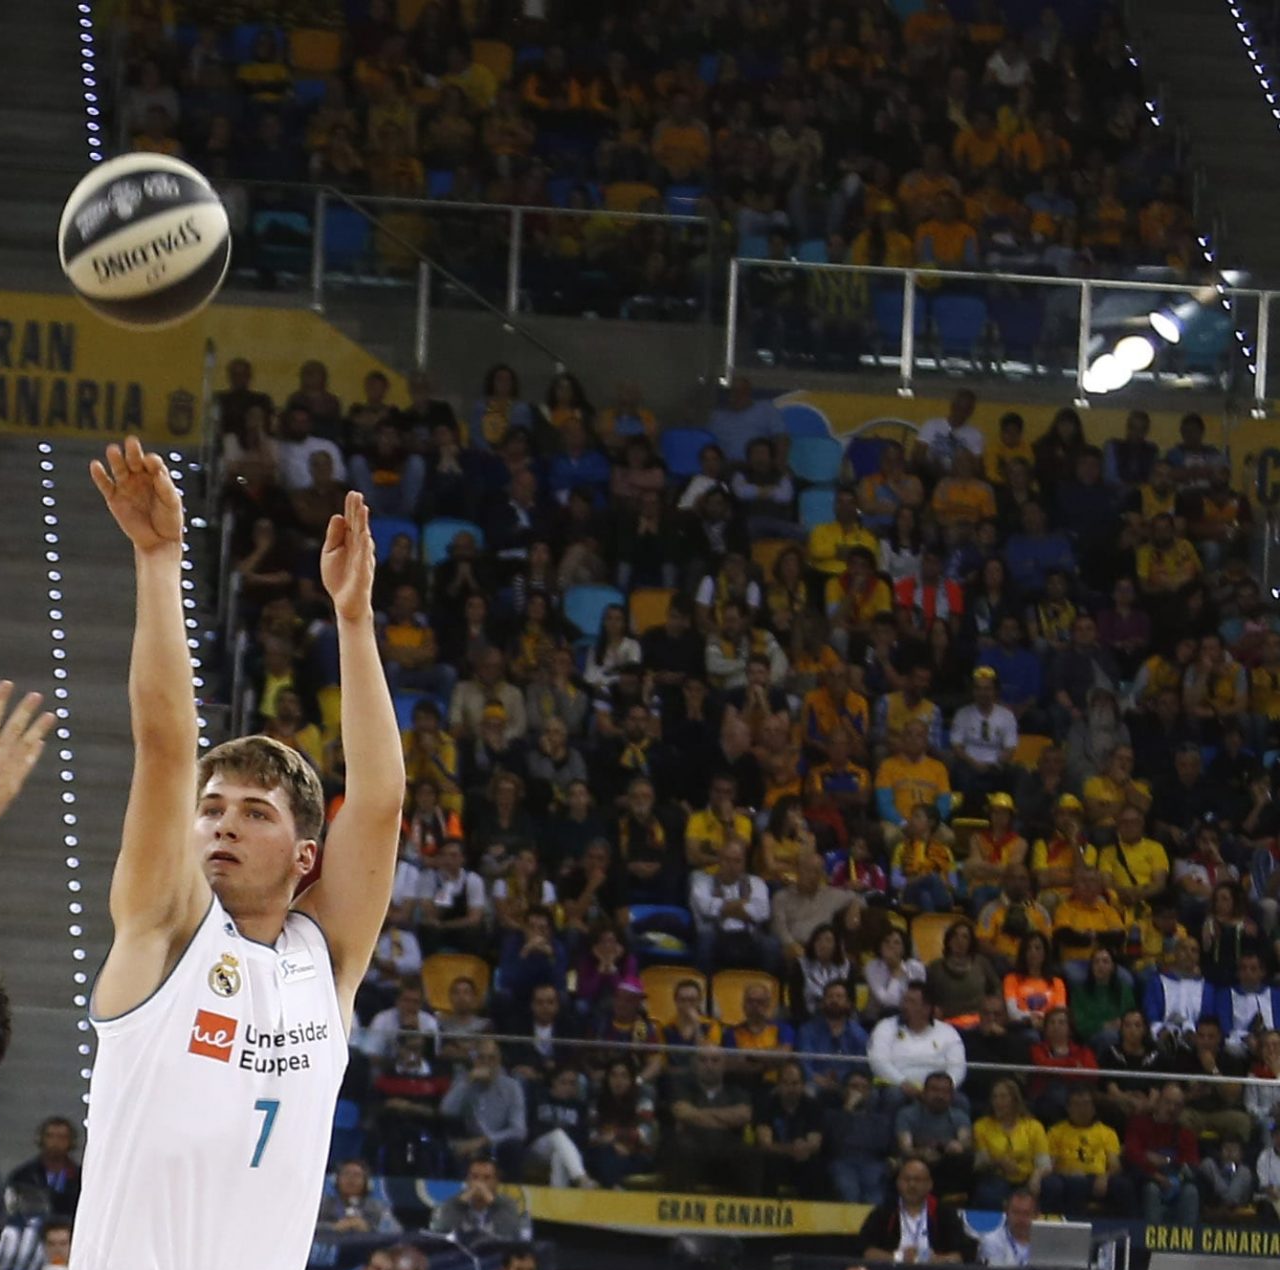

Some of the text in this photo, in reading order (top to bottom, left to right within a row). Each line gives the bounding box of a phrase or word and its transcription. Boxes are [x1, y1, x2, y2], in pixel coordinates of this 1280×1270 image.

[249, 1099, 281, 1168] 7
[658, 1200, 795, 1227] GRAN CANARIA
[1146, 1224, 1280, 1257] GRAN CANARIA
